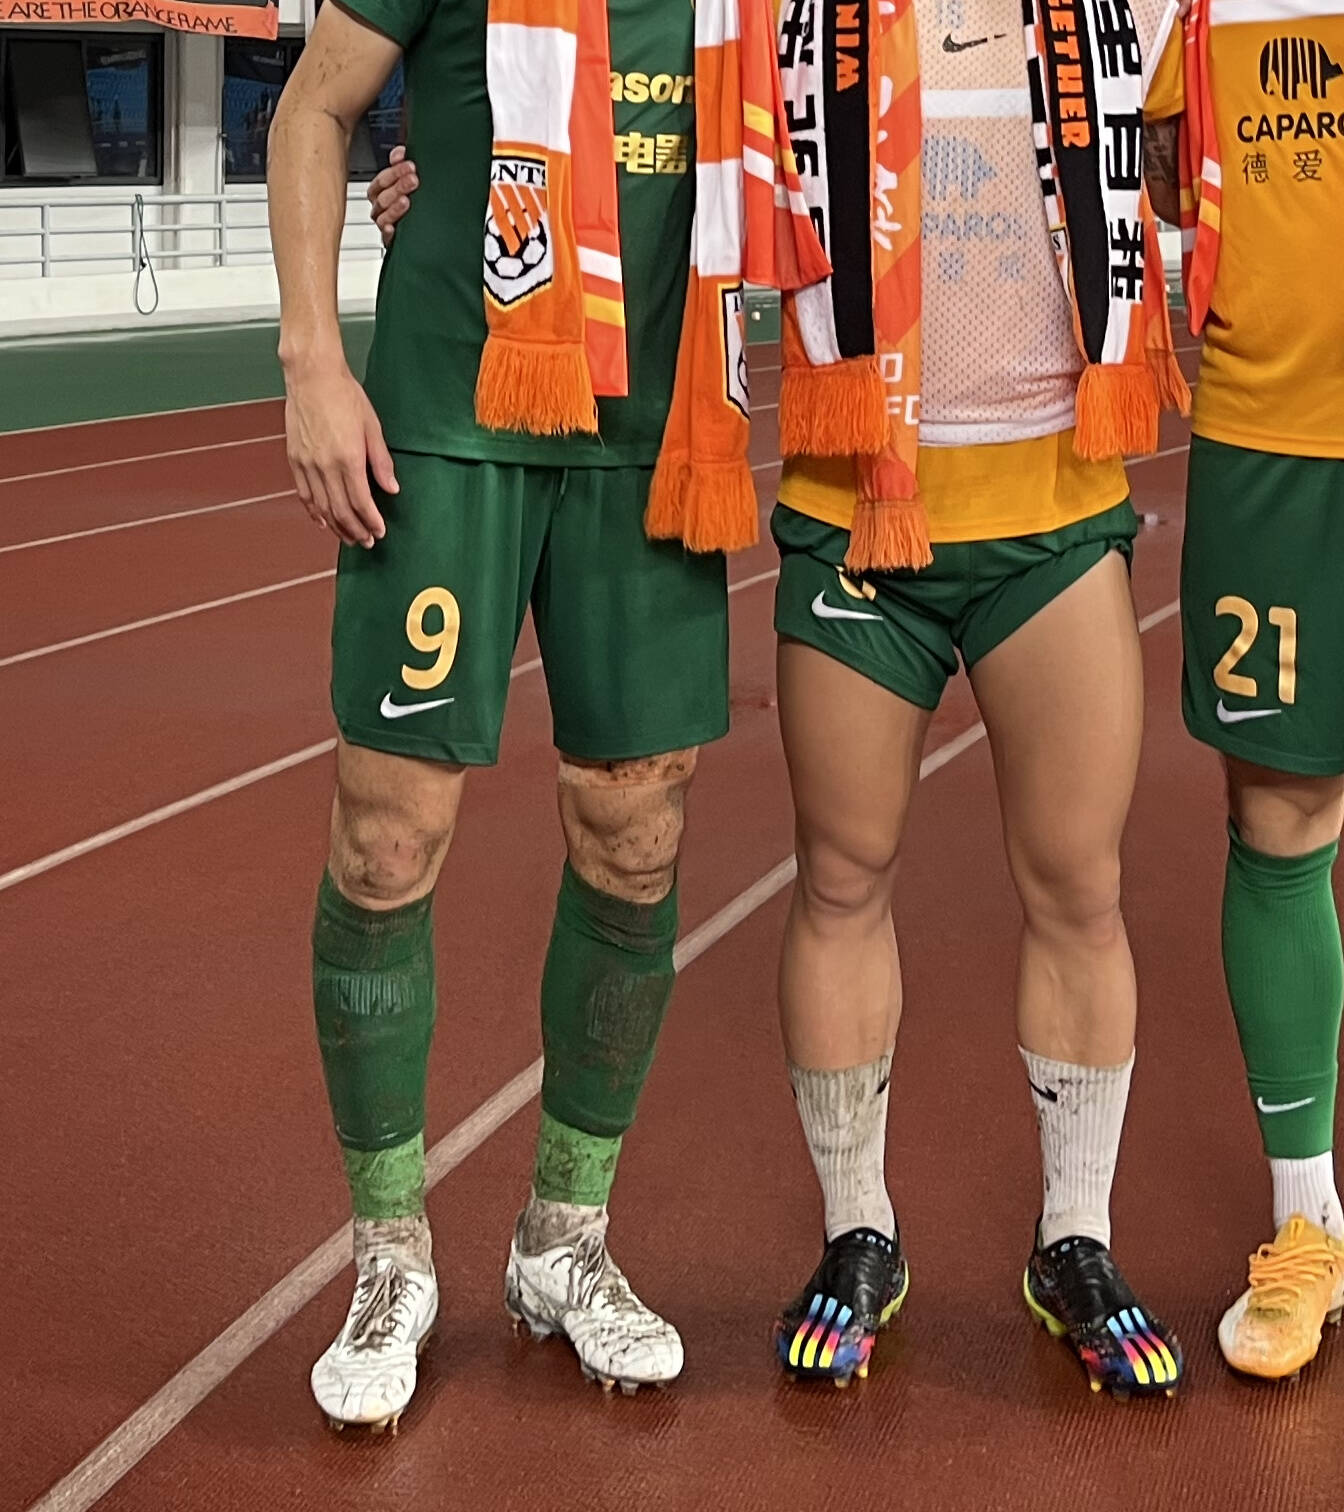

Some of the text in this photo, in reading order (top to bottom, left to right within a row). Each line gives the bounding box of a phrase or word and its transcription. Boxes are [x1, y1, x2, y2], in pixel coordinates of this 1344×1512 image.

[8, 1, 52, 19] ARE
[52, 1, 98, 19] THE
[836, 2, 860, 92] WIN
[610, 71, 694, 105] asor
[613, 131, 688, 175] 电器
[401, 586, 461, 690] 9
[1213, 595, 1297, 705] 21
